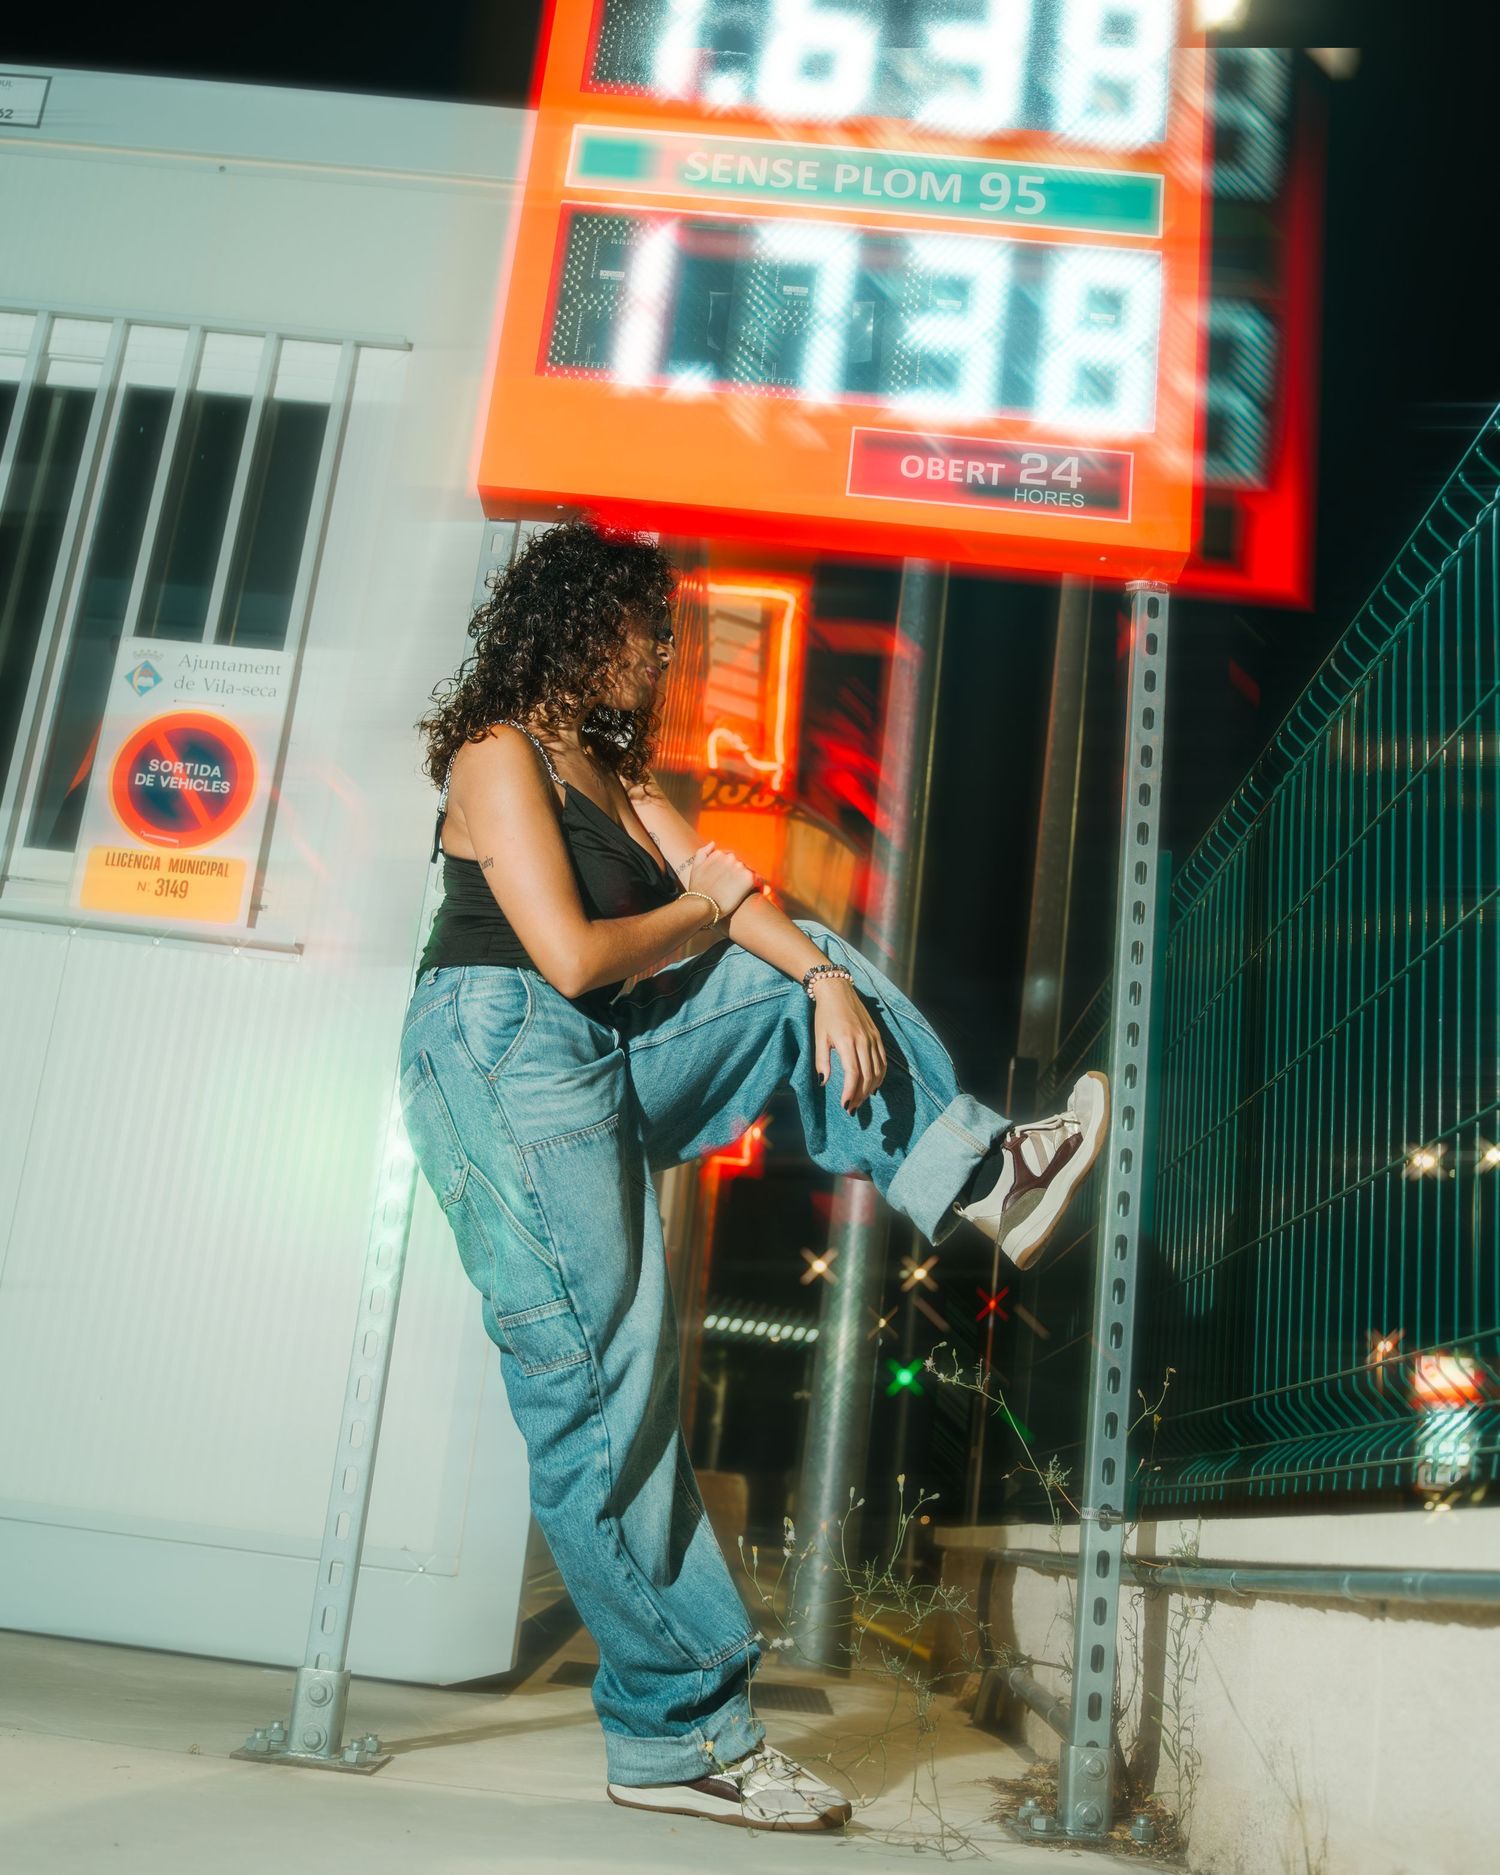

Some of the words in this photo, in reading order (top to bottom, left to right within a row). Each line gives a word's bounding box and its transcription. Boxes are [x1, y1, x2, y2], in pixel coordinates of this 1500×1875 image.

[684, 151, 820, 191] SENSE
[834, 164, 962, 203] PLOM
[978, 172, 1046, 215] 95
[612, 218, 1162, 433] 1.738
[900, 454, 1006, 486] OBERT
[1019, 452, 1082, 489] 24
[1014, 487, 1085, 508] HORES
[178, 654, 280, 676] Ajuntament
[173, 675, 195, 690] de
[204, 677, 277, 698] Vila-seca
[148, 759, 221, 778] SORTIDA
[134, 773, 156, 787] DE
[160, 775, 231, 794] VEHICLES
[168, 857, 230, 878] MUNICIPAL
[154, 878, 189, 899] 3149
